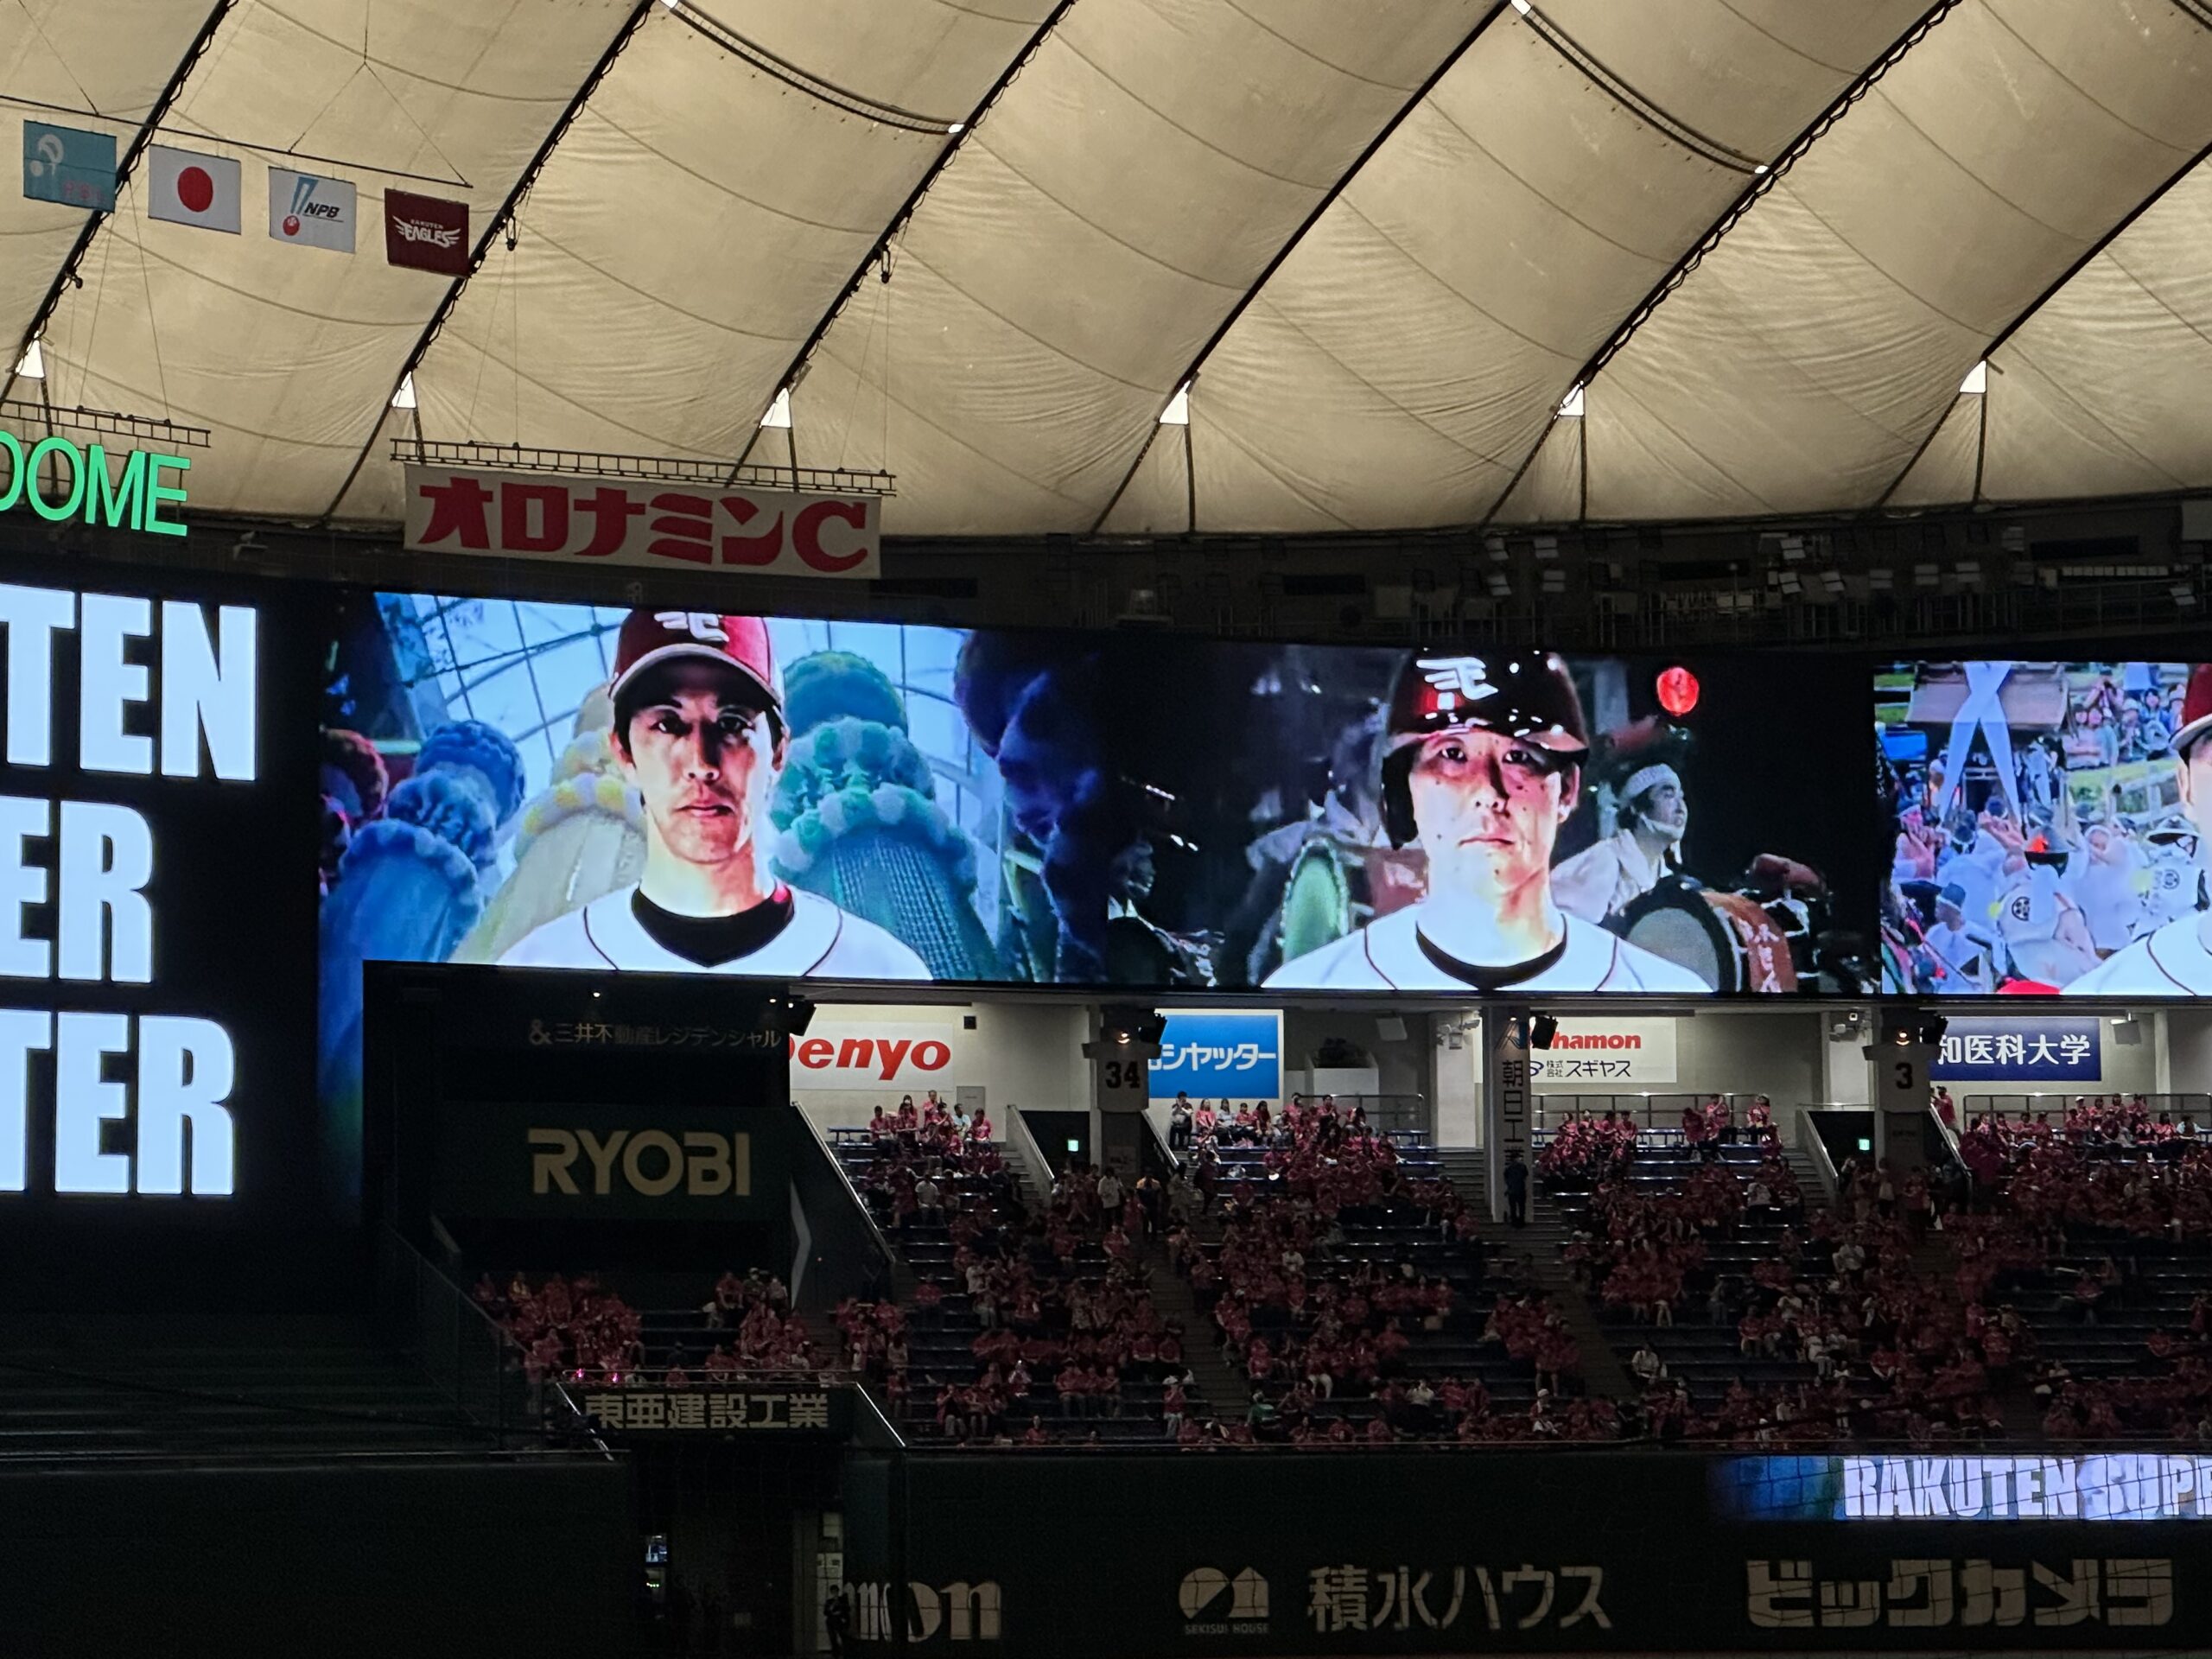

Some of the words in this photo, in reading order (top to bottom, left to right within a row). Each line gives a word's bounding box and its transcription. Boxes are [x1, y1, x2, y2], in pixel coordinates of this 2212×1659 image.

[304, 202, 340, 219] NPB
[398, 221, 456, 248] EAGLES
[417, 477, 868, 573] オロナミンC
[1553, 1033, 1641, 1049] hamon
[1106, 1061, 1140, 1088] 34
[1566, 1060, 1631, 1077] スギヤス
[1895, 1063, 1912, 1089] 3
[528, 1128, 750, 1197] RYOBI
[585, 1394, 829, 1429] 東亜建設工業
[1843, 1458, 2077, 1516] RAKUTEN
[1307, 1564, 1613, 1633] 積水ハウス
[1746, 1559, 2174, 1627] ビックカメラ
[1185, 1624, 1229, 1634] SEKISUI
[1233, 1624, 1269, 1633] HOUSE
